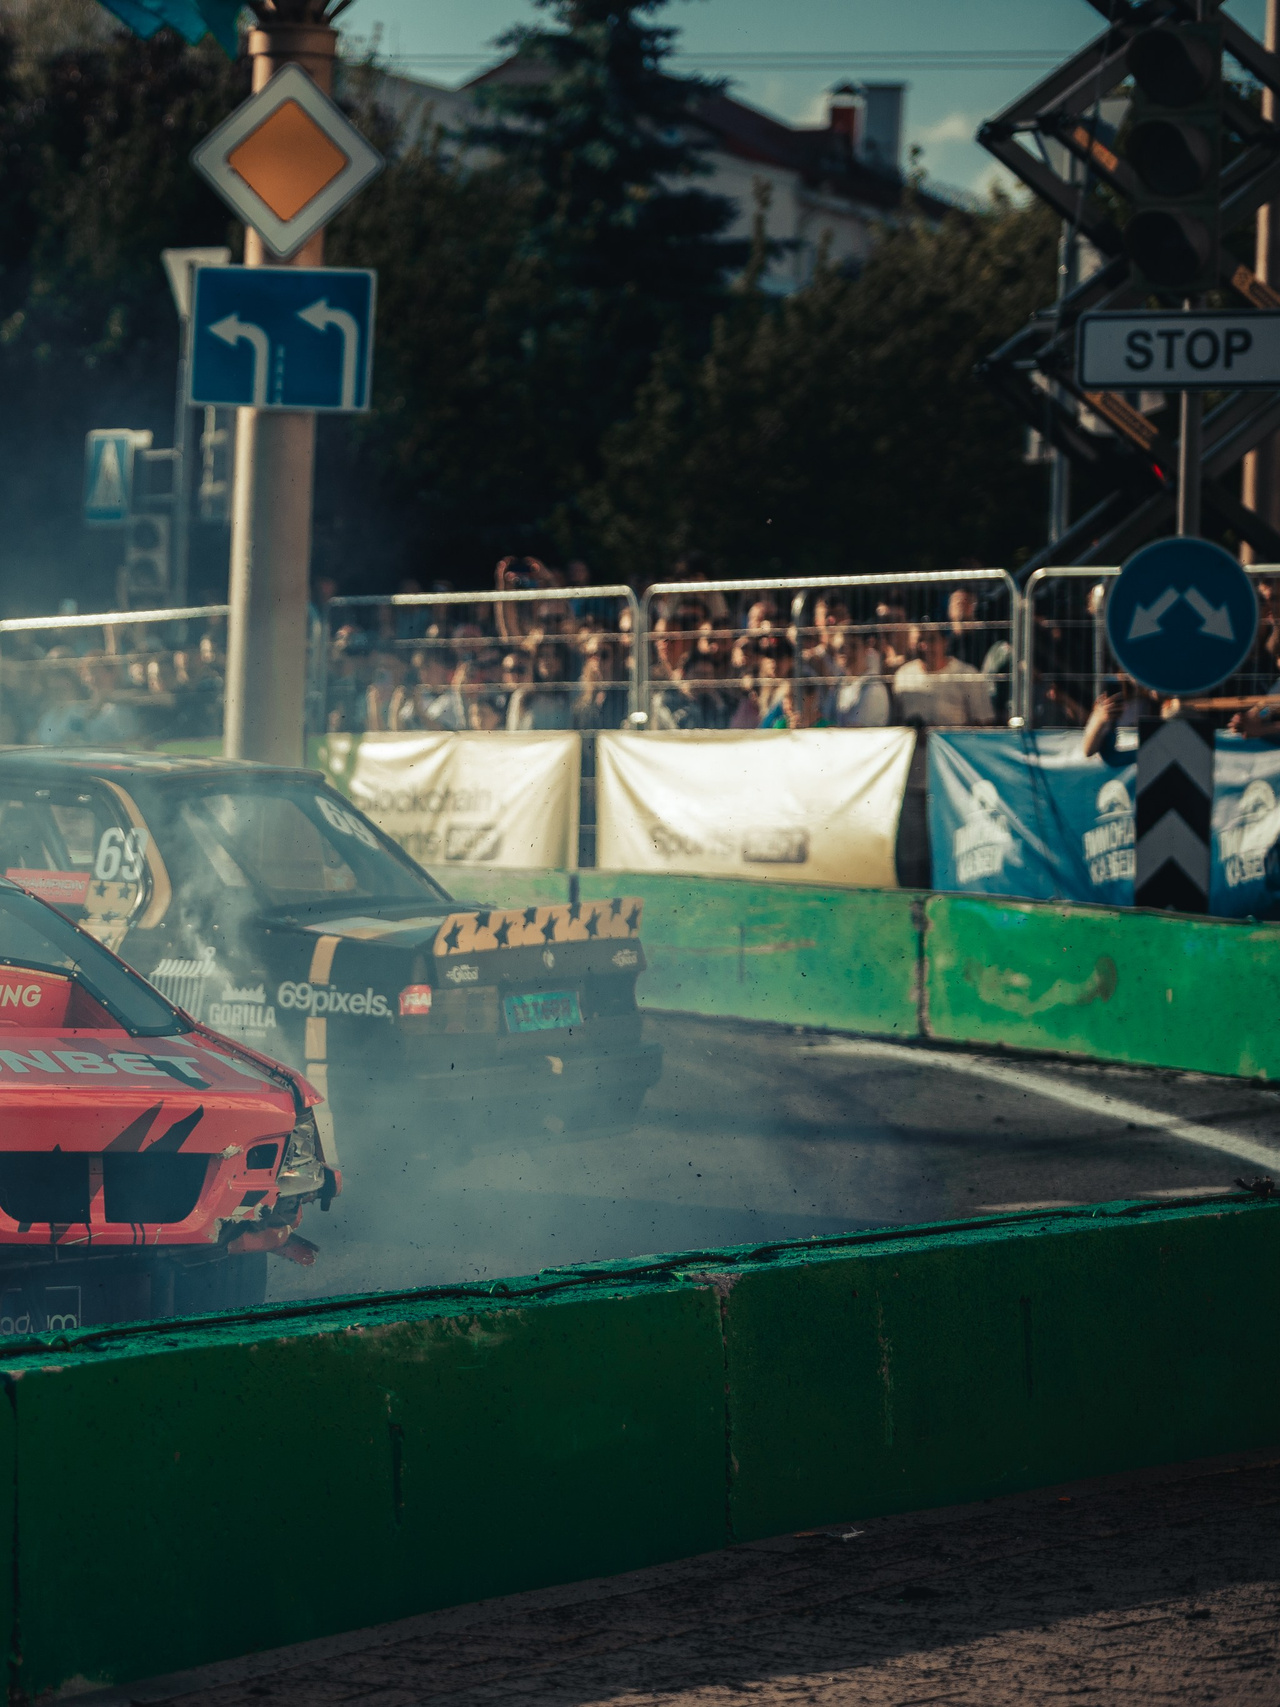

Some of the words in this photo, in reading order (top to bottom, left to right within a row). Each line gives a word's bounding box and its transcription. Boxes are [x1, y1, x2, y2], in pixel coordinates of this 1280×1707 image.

[1124, 327, 1253, 370] STOP
[95, 827, 148, 880] 69
[209, 1002, 277, 1028] GORILLA
